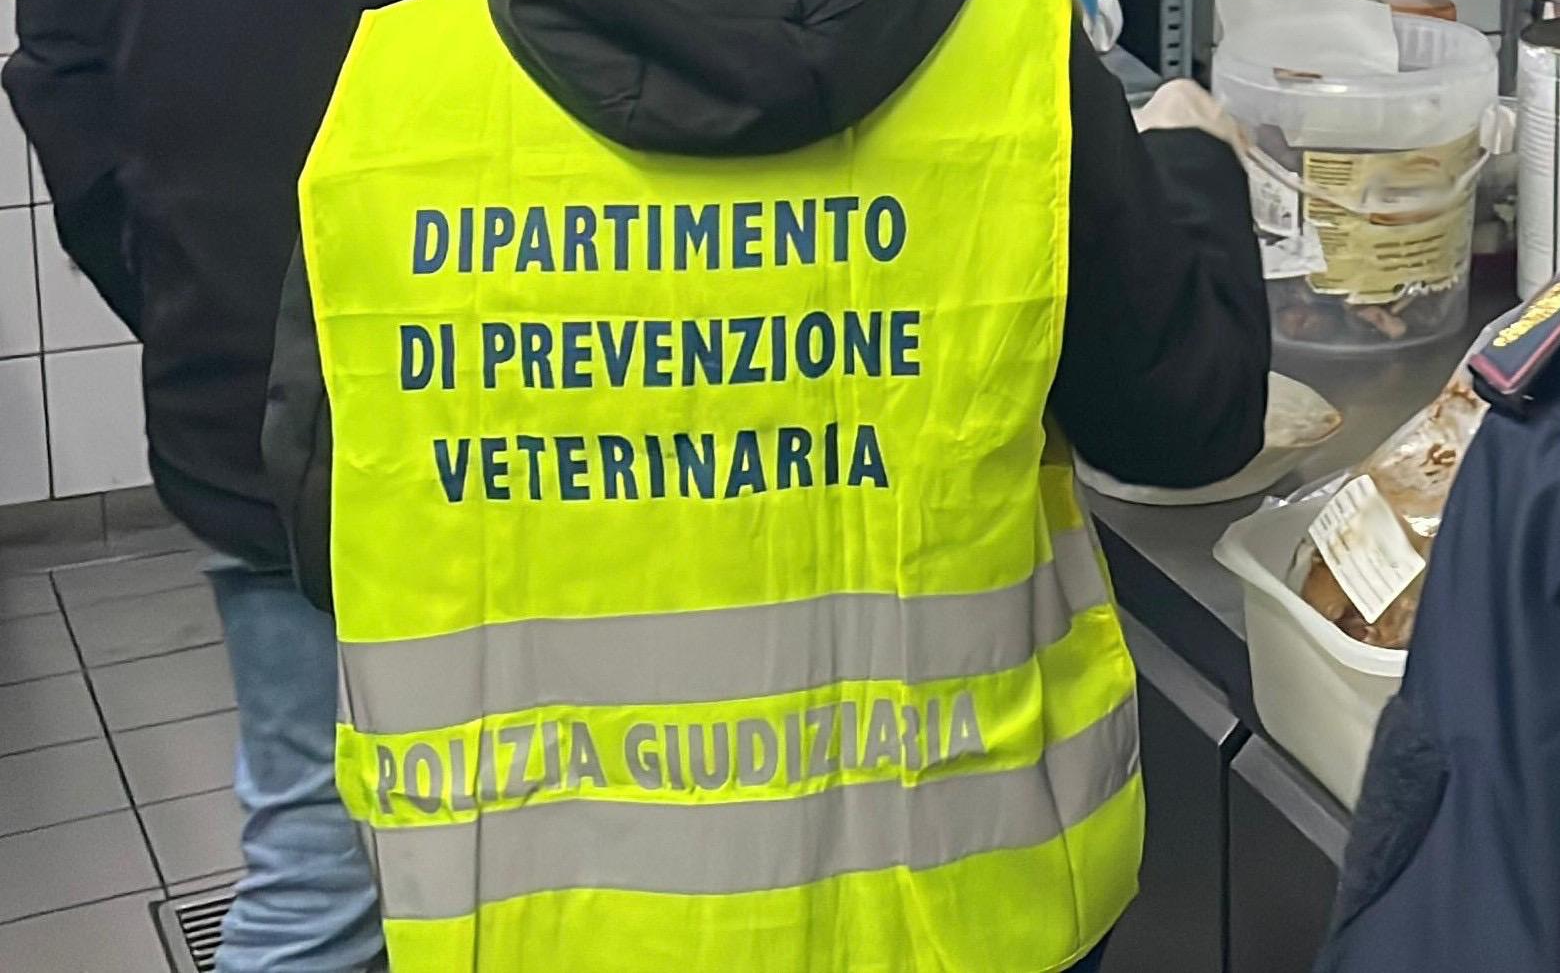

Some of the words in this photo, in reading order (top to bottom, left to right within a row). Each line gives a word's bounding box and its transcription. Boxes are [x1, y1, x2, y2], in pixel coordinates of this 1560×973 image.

[412, 195, 907, 275] DIPARTIMENTO
[399, 323, 456, 391] DI
[481, 310, 921, 389] PREVENZIONE
[433, 420, 890, 503] VETERINARIA
[377, 720, 607, 814] POLIZIA
[623, 691, 986, 790] GIUDIZIARIA
